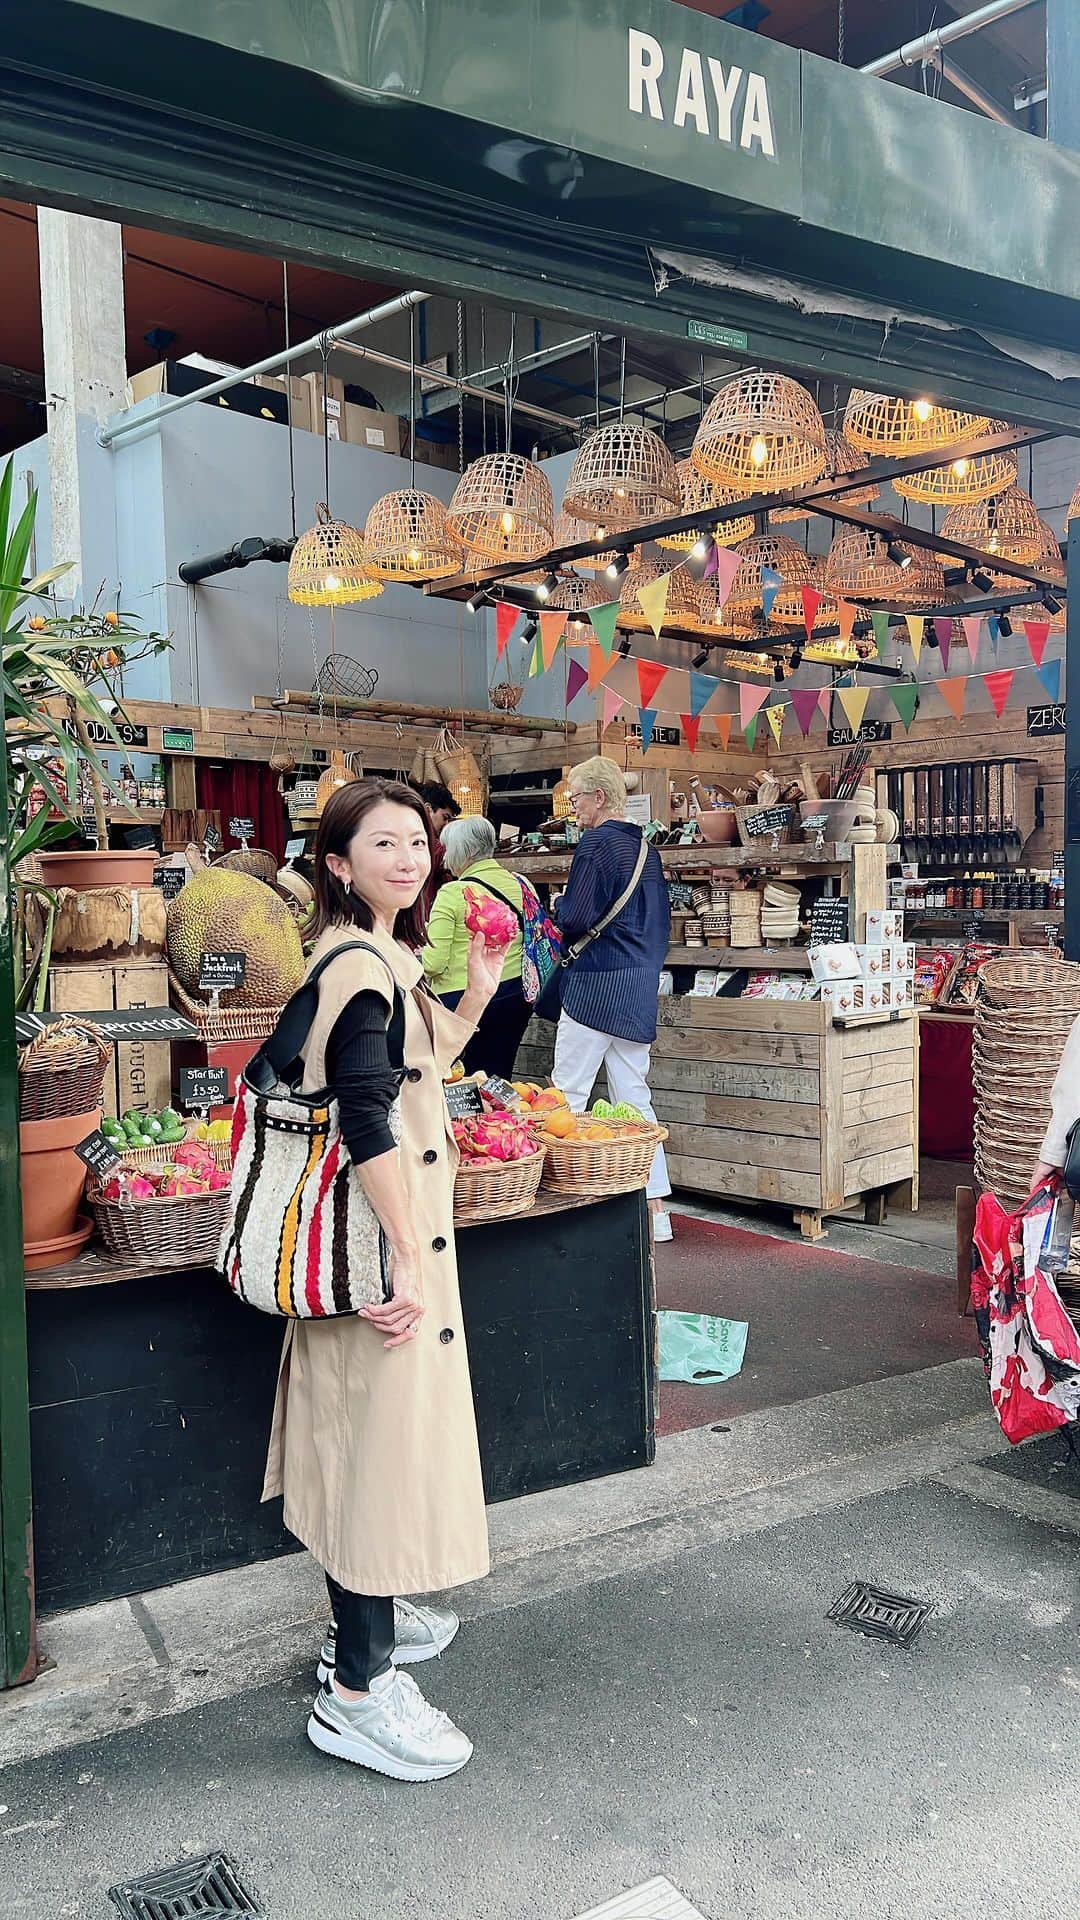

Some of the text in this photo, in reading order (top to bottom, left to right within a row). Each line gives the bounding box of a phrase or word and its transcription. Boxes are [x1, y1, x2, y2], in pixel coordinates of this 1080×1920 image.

[628, 27, 775, 157] RAYA
[64, 720, 134, 743] NODLS
[635, 724, 667, 742] PTE
[832, 726, 877, 744] SAUCES
[187, 1069, 207, 1080] Star
[266, 1118, 323, 1133] MARNI
